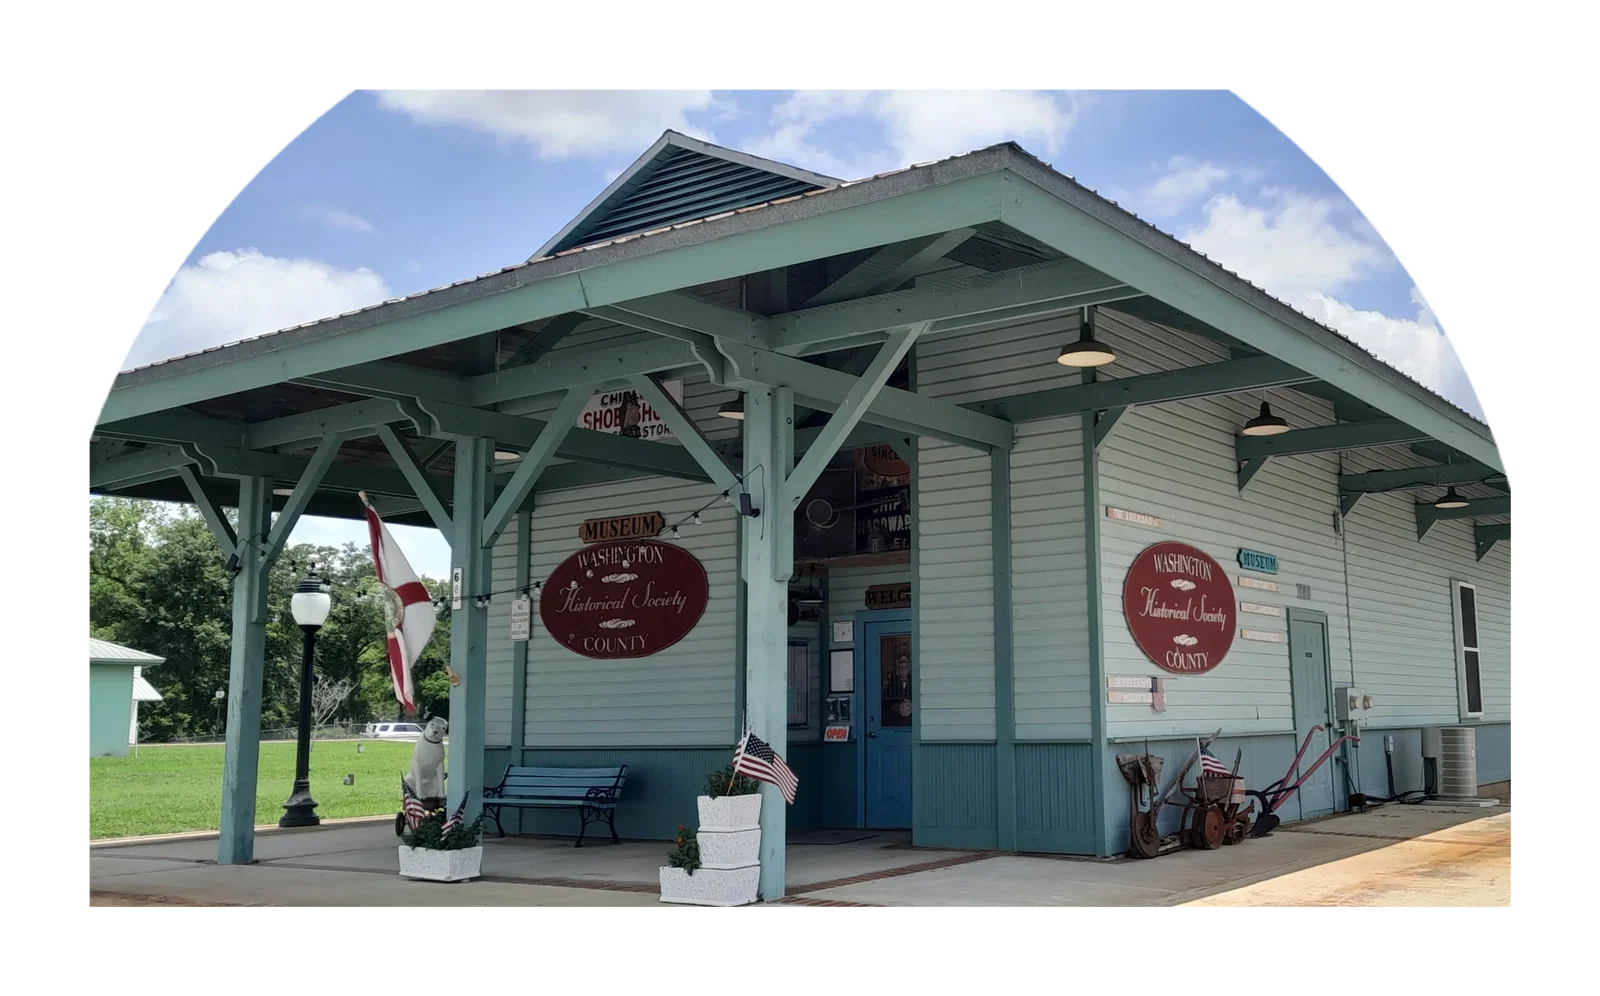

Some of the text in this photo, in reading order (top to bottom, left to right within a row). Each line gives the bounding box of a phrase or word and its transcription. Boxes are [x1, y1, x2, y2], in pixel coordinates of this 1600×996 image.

[585, 515, 656, 541] MUSEUM
[577, 545, 663, 570] WASHINGTON
[1154, 552, 1212, 583] WASHINGTON
[1243, 552, 1277, 571] MUSEUM
[556, 581, 687, 614] Historical Society
[1139, 586, 1227, 631] Historical Society
[583, 634, 649, 652] COUNTY
[1166, 650, 1209, 670] COUNTY
[826, 728, 848, 739] OPEN
